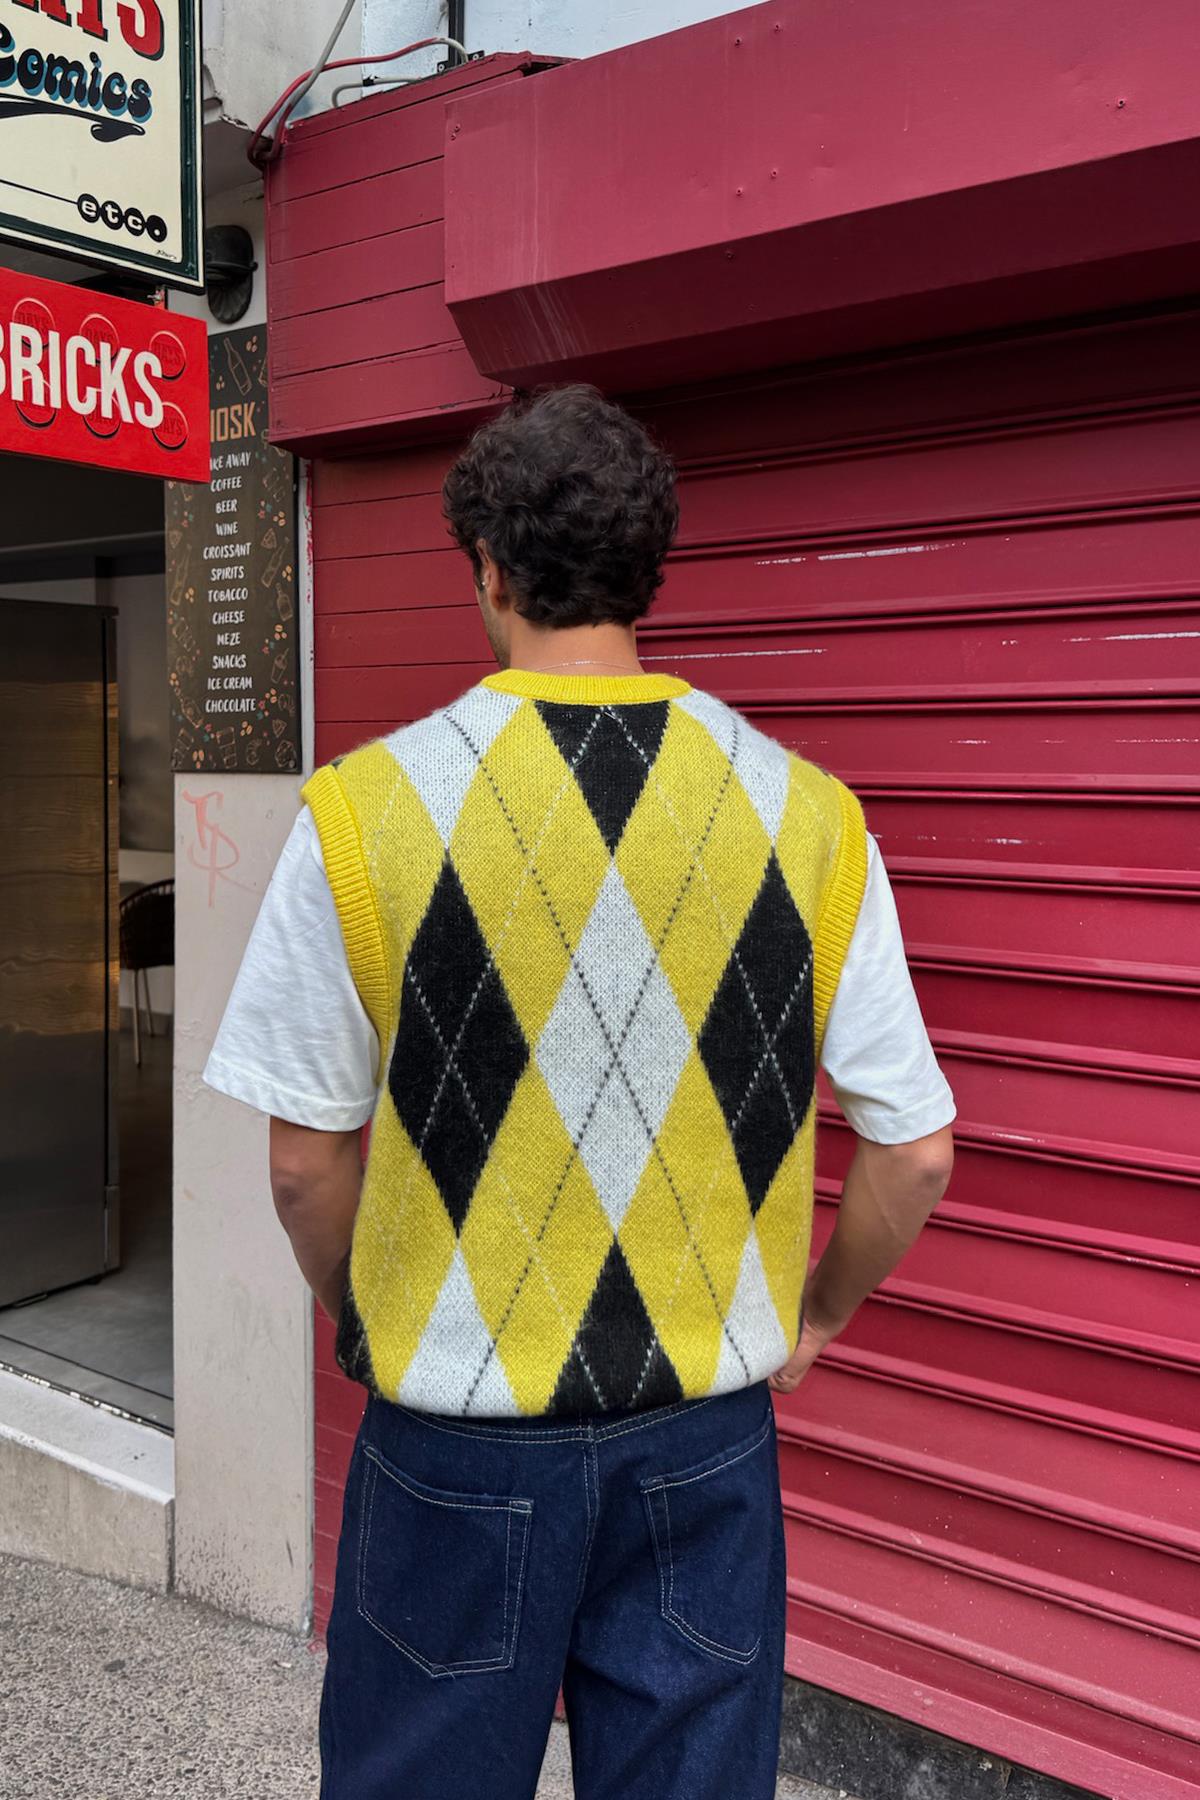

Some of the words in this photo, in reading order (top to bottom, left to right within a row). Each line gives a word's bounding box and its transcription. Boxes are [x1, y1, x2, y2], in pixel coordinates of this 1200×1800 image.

[0, 322, 165, 429] RICKS
[210, 401, 256, 443] IOSK
[209, 455, 224, 471] KE
[225, 451, 252, 469] AWAY
[210, 475, 242, 493] COFFEE
[215, 499, 238, 514] BEER
[215, 521, 239, 536] WINE
[203, 542, 251, 560] CROISSANT
[210, 565, 244, 582] SPIRITS
[207, 587, 249, 604] TOBACCO
[212, 610, 245, 625] CHEESE
[216, 632, 241, 646] MEZE
[212, 654, 247, 670] SNACKS
[207, 677, 222, 690] ICE
[223, 676, 253, 690] CREAM
[205, 698, 257, 713] CHOCOLATE
